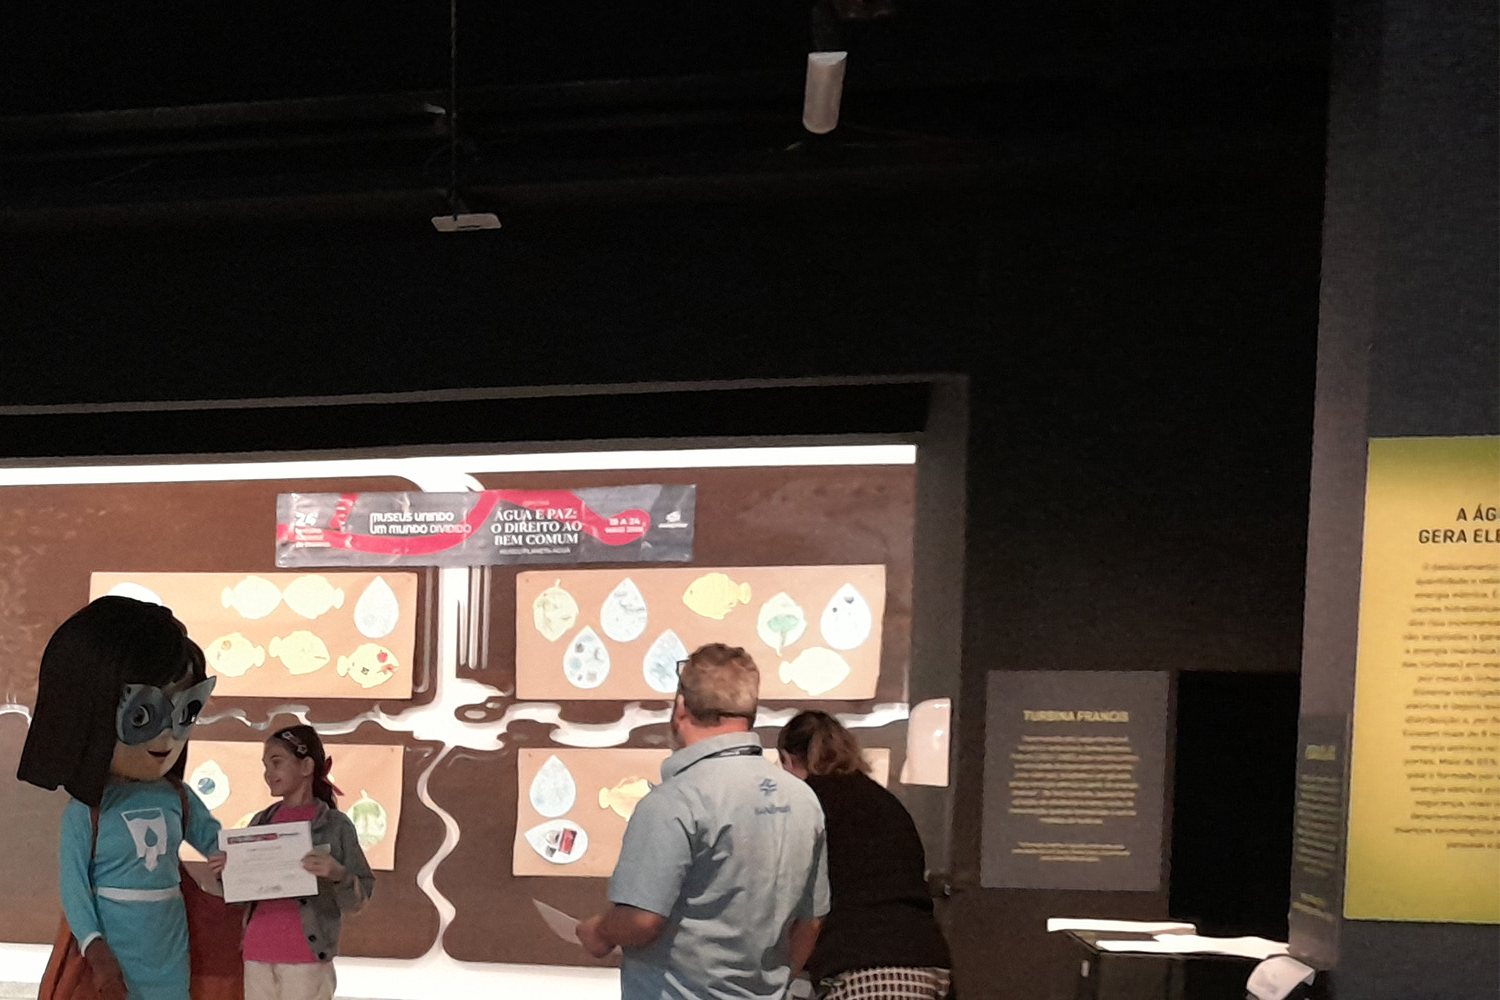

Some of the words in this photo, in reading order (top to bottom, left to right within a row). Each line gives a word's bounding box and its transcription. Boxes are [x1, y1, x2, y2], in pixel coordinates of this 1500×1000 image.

[369, 512, 412, 522] MUSEUS
[414, 511, 454, 521] UNINDO
[494, 507, 533, 521] ÁGUA
[535, 509, 545, 520] E
[1456, 507, 1468, 521] A
[388, 523, 428, 534] MUNDO
[490, 522, 502, 533] O
[504, 521, 560, 533] DIREITO
[562, 520, 583, 532] AO
[494, 535, 524, 546] BEM
[525, 533, 579, 545] COMUM
[1418, 528, 1468, 544] GERA
